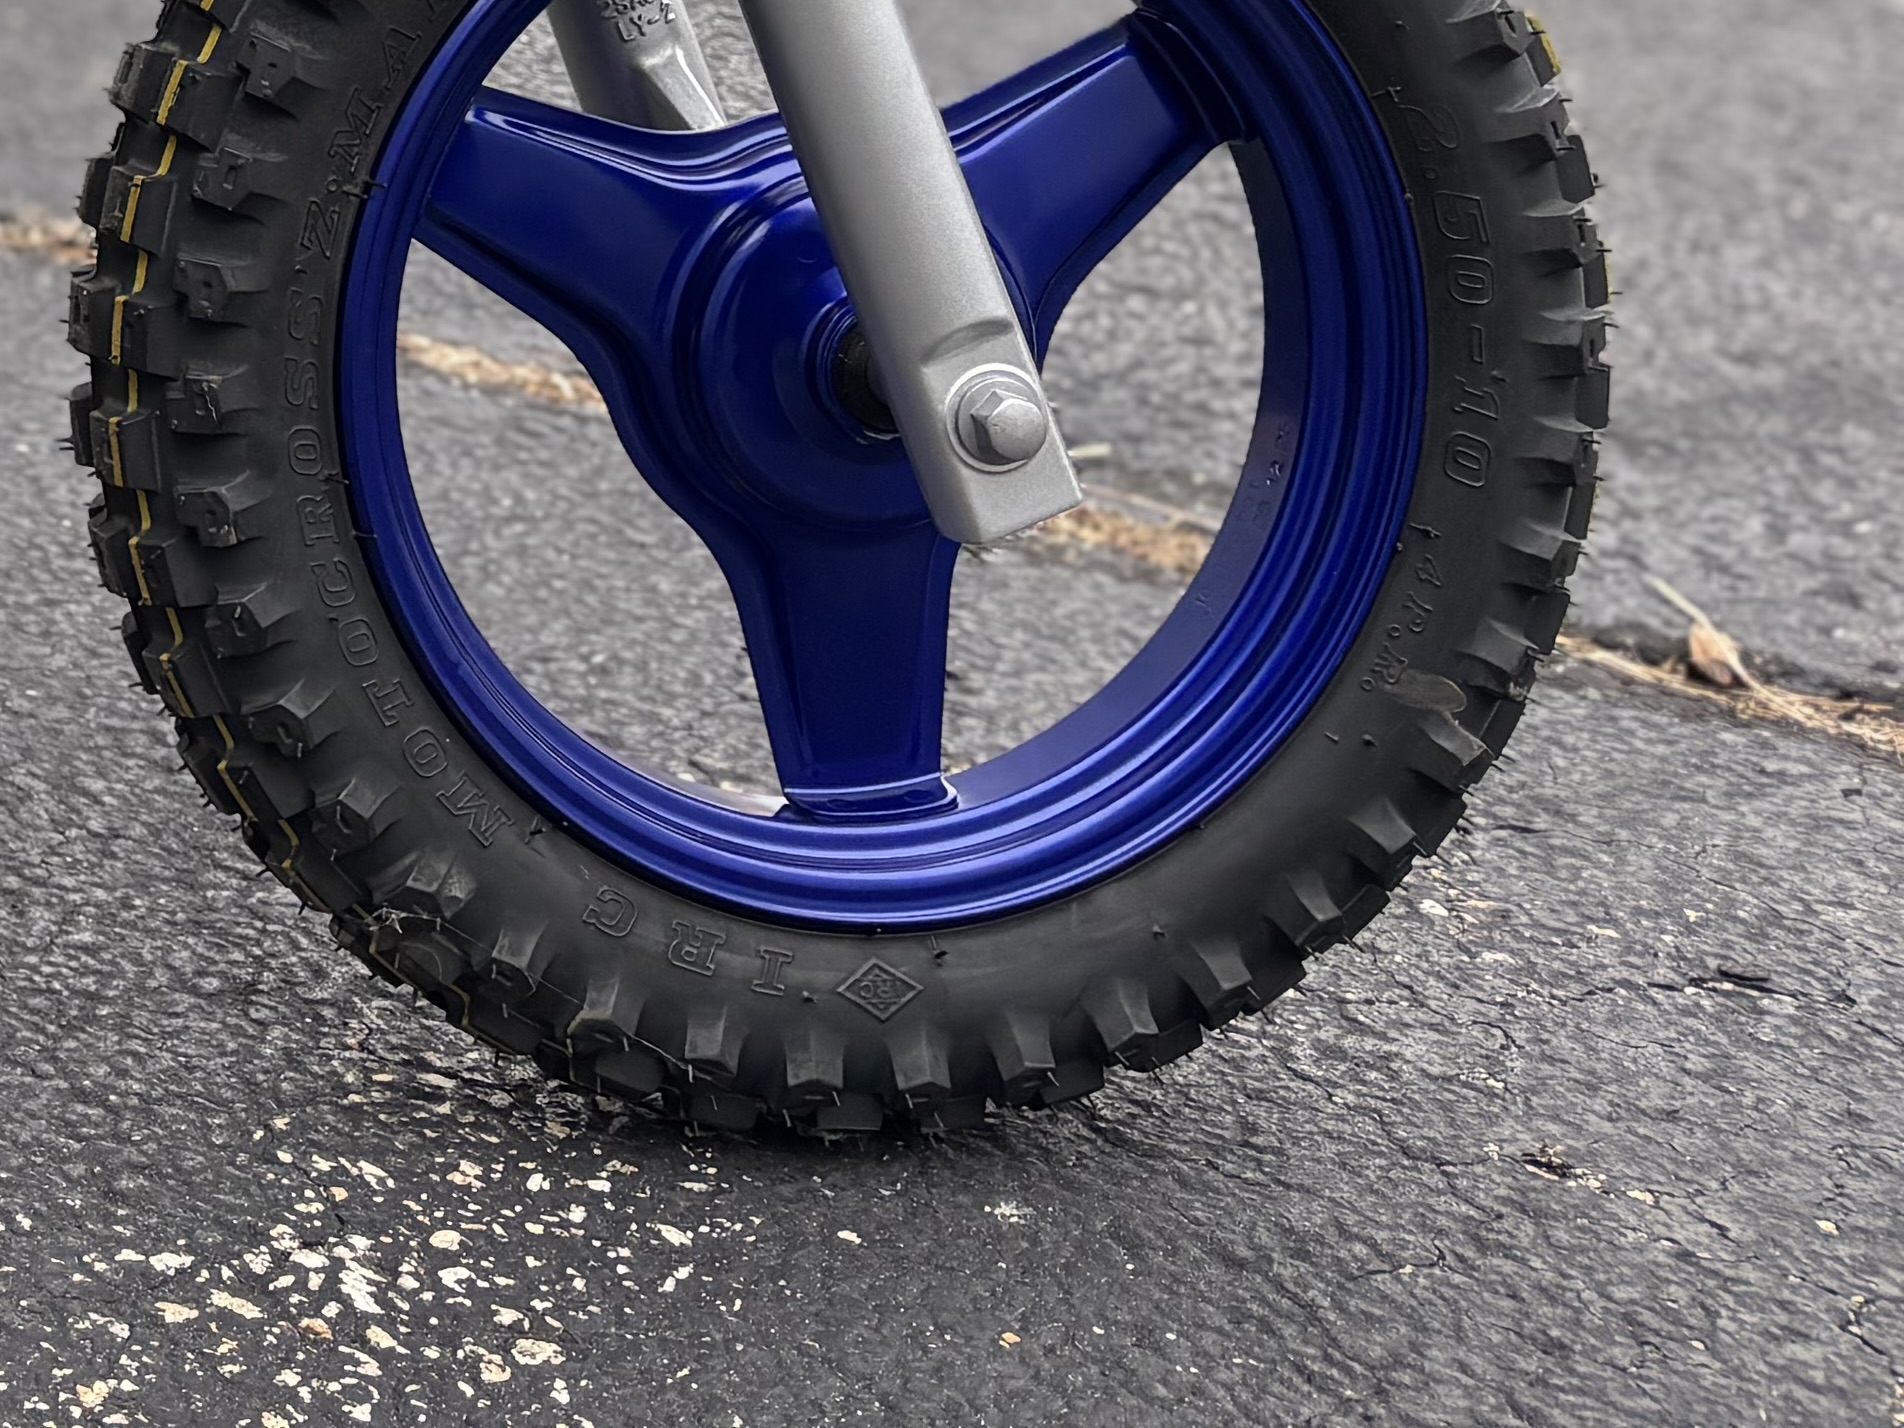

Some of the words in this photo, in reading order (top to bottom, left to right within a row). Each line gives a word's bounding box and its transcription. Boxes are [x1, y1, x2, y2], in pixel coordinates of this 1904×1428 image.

[1398, 100, 1502, 489] 2.50-10
[282, 286, 515, 848] MOTOCROSS
[582, 885, 794, 997] IRC
